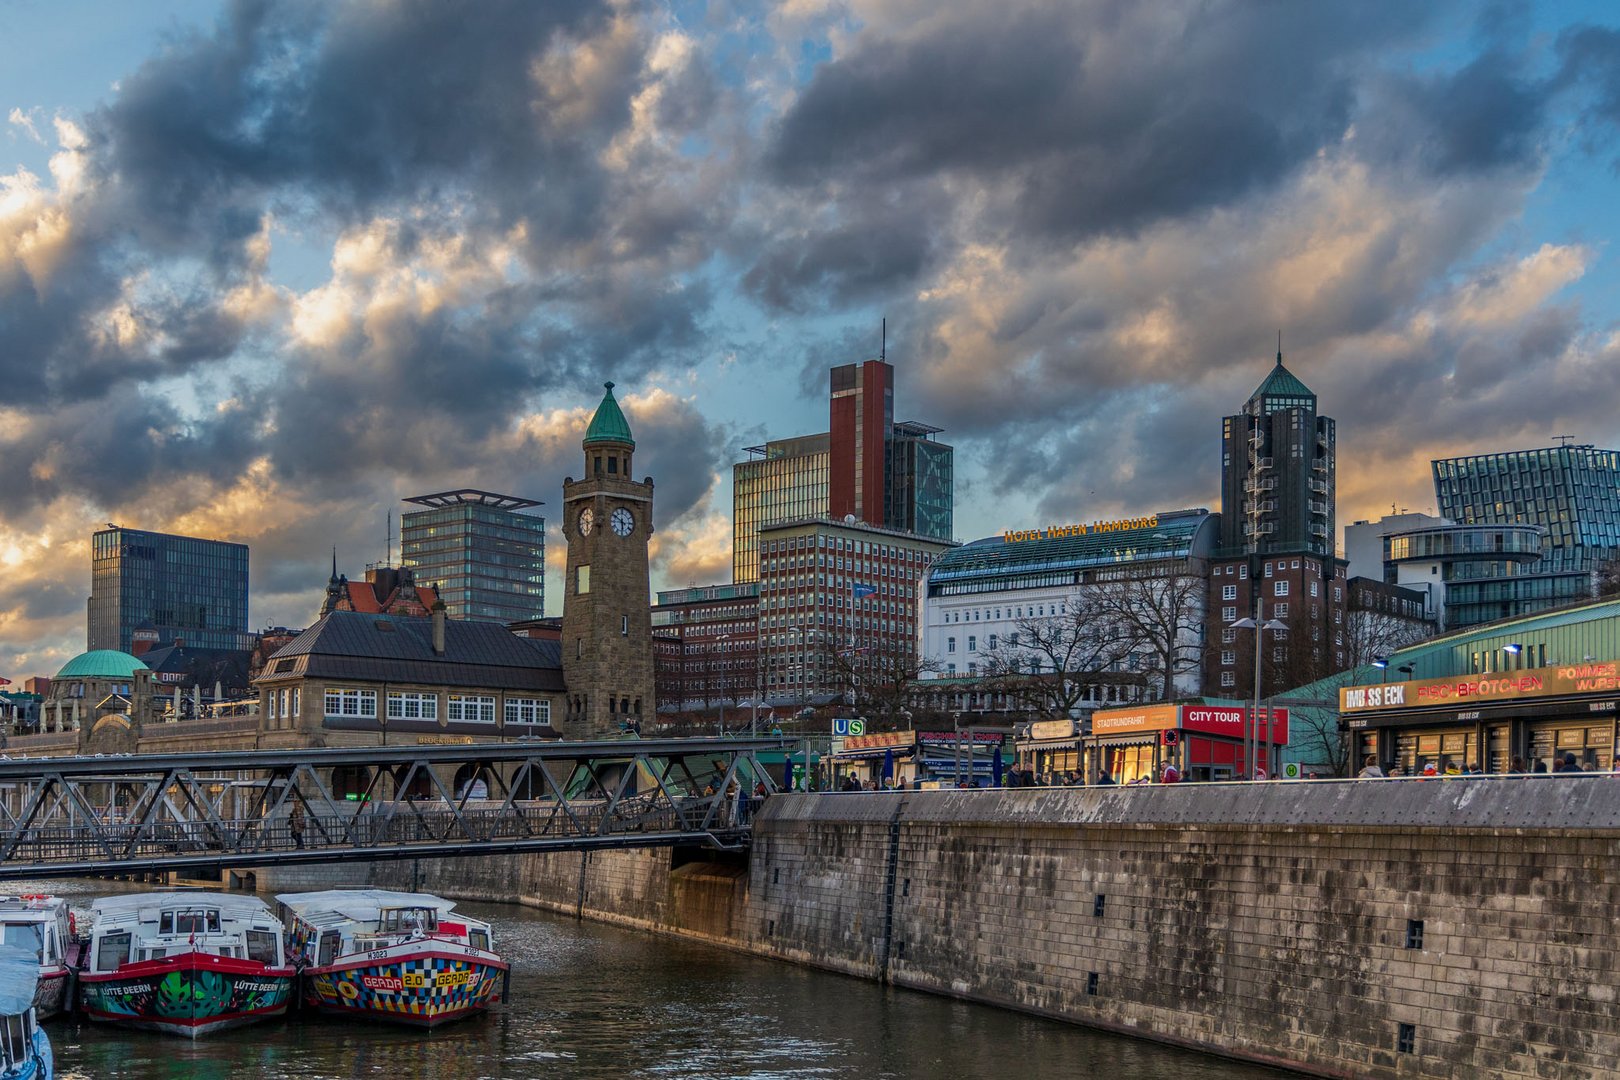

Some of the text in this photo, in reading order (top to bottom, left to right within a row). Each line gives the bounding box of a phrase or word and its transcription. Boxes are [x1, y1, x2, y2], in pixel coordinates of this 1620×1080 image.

[1004, 516, 1158, 543] HOTEL HAFEN HAMBURG
[1558, 664, 1616, 680] POMMES
[1417, 675, 1543, 700] FISCHBRÖTCHEN
[1346, 685, 1404, 708] IMBISS ECK
[1096, 715, 1146, 729] STADTRUNDFAHRT
[1189, 712, 1212, 722] CITY
[1213, 712, 1240, 722] TOUR
[835, 720, 861, 734] U S
[234, 980, 259, 991] LÜTTE
[259, 983, 279, 992] DEERN
[404, 975, 423, 986] 2.0
[122, 984, 152, 995] DEERN
